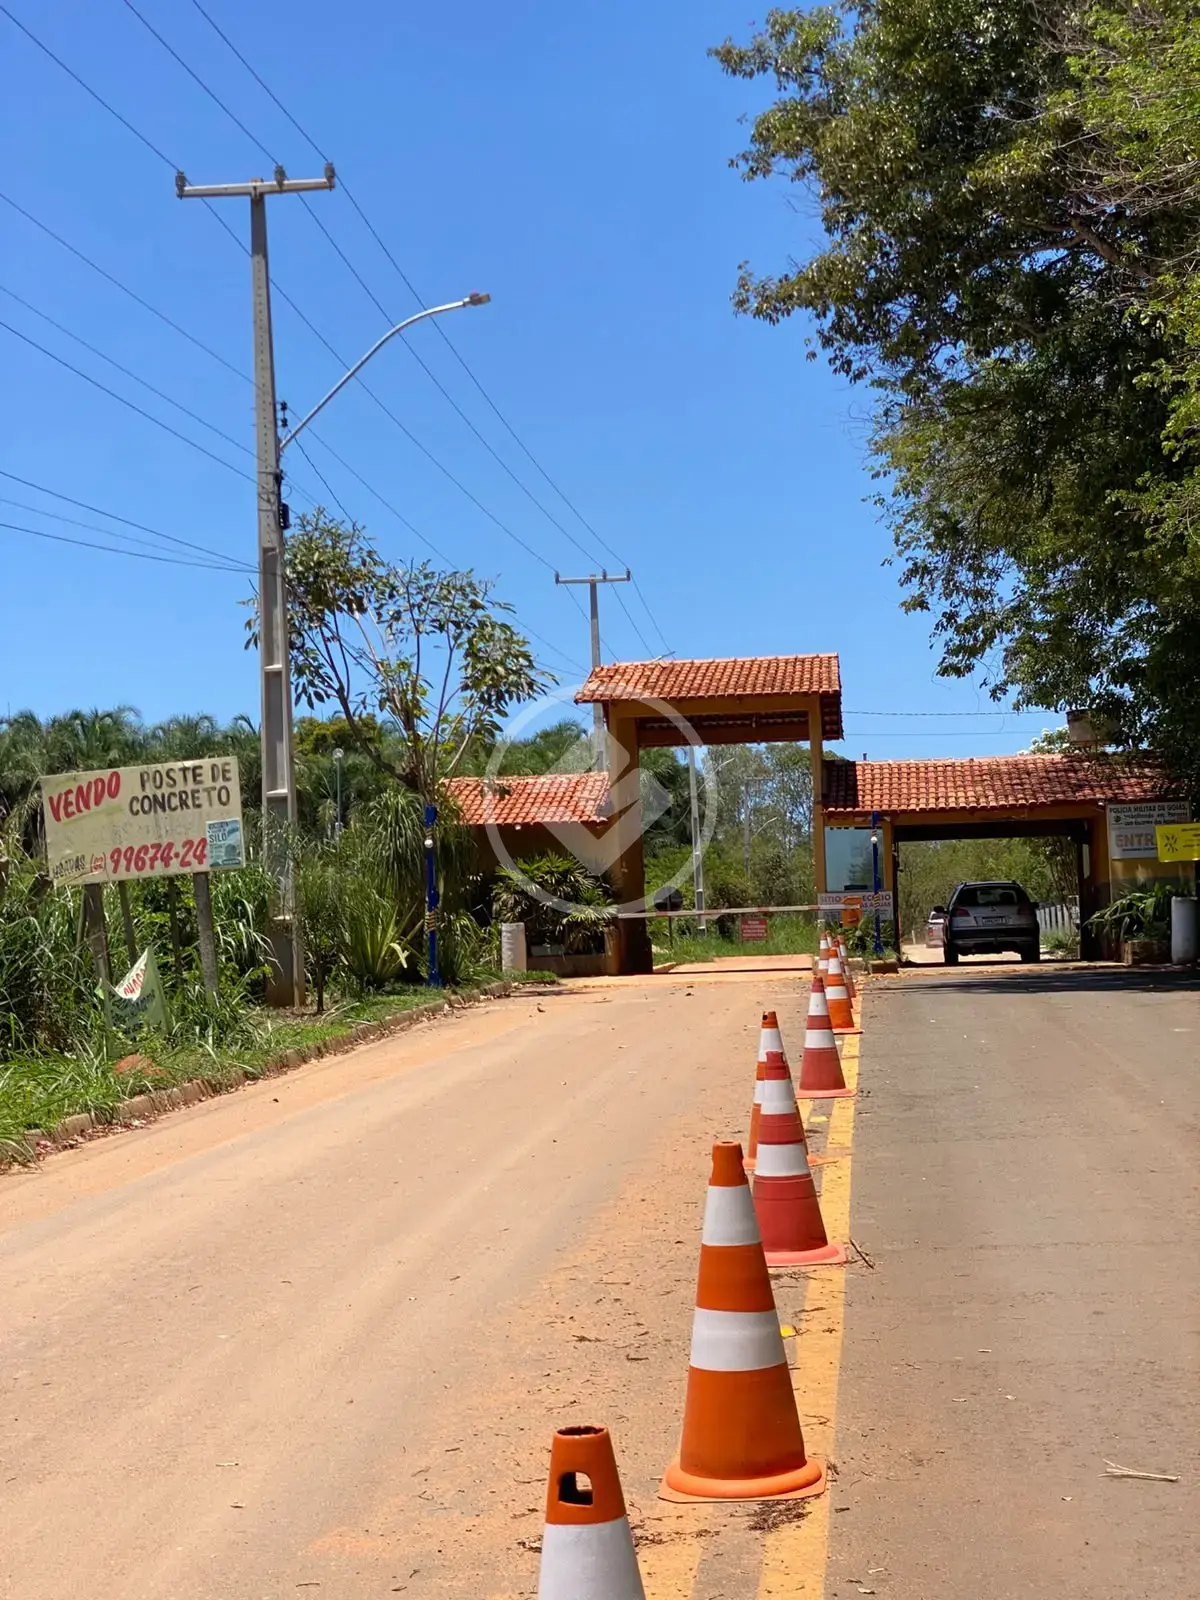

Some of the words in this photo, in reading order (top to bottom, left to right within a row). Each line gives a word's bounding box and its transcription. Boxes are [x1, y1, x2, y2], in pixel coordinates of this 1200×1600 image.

[140, 765, 203, 792] POSTE
[211, 762, 232, 783] DE
[48, 771, 121, 822] VENDO
[129, 785, 230, 816] CONCRETO
[209, 832, 227, 843] SILO
[1116, 833, 1156, 848] ENTR
